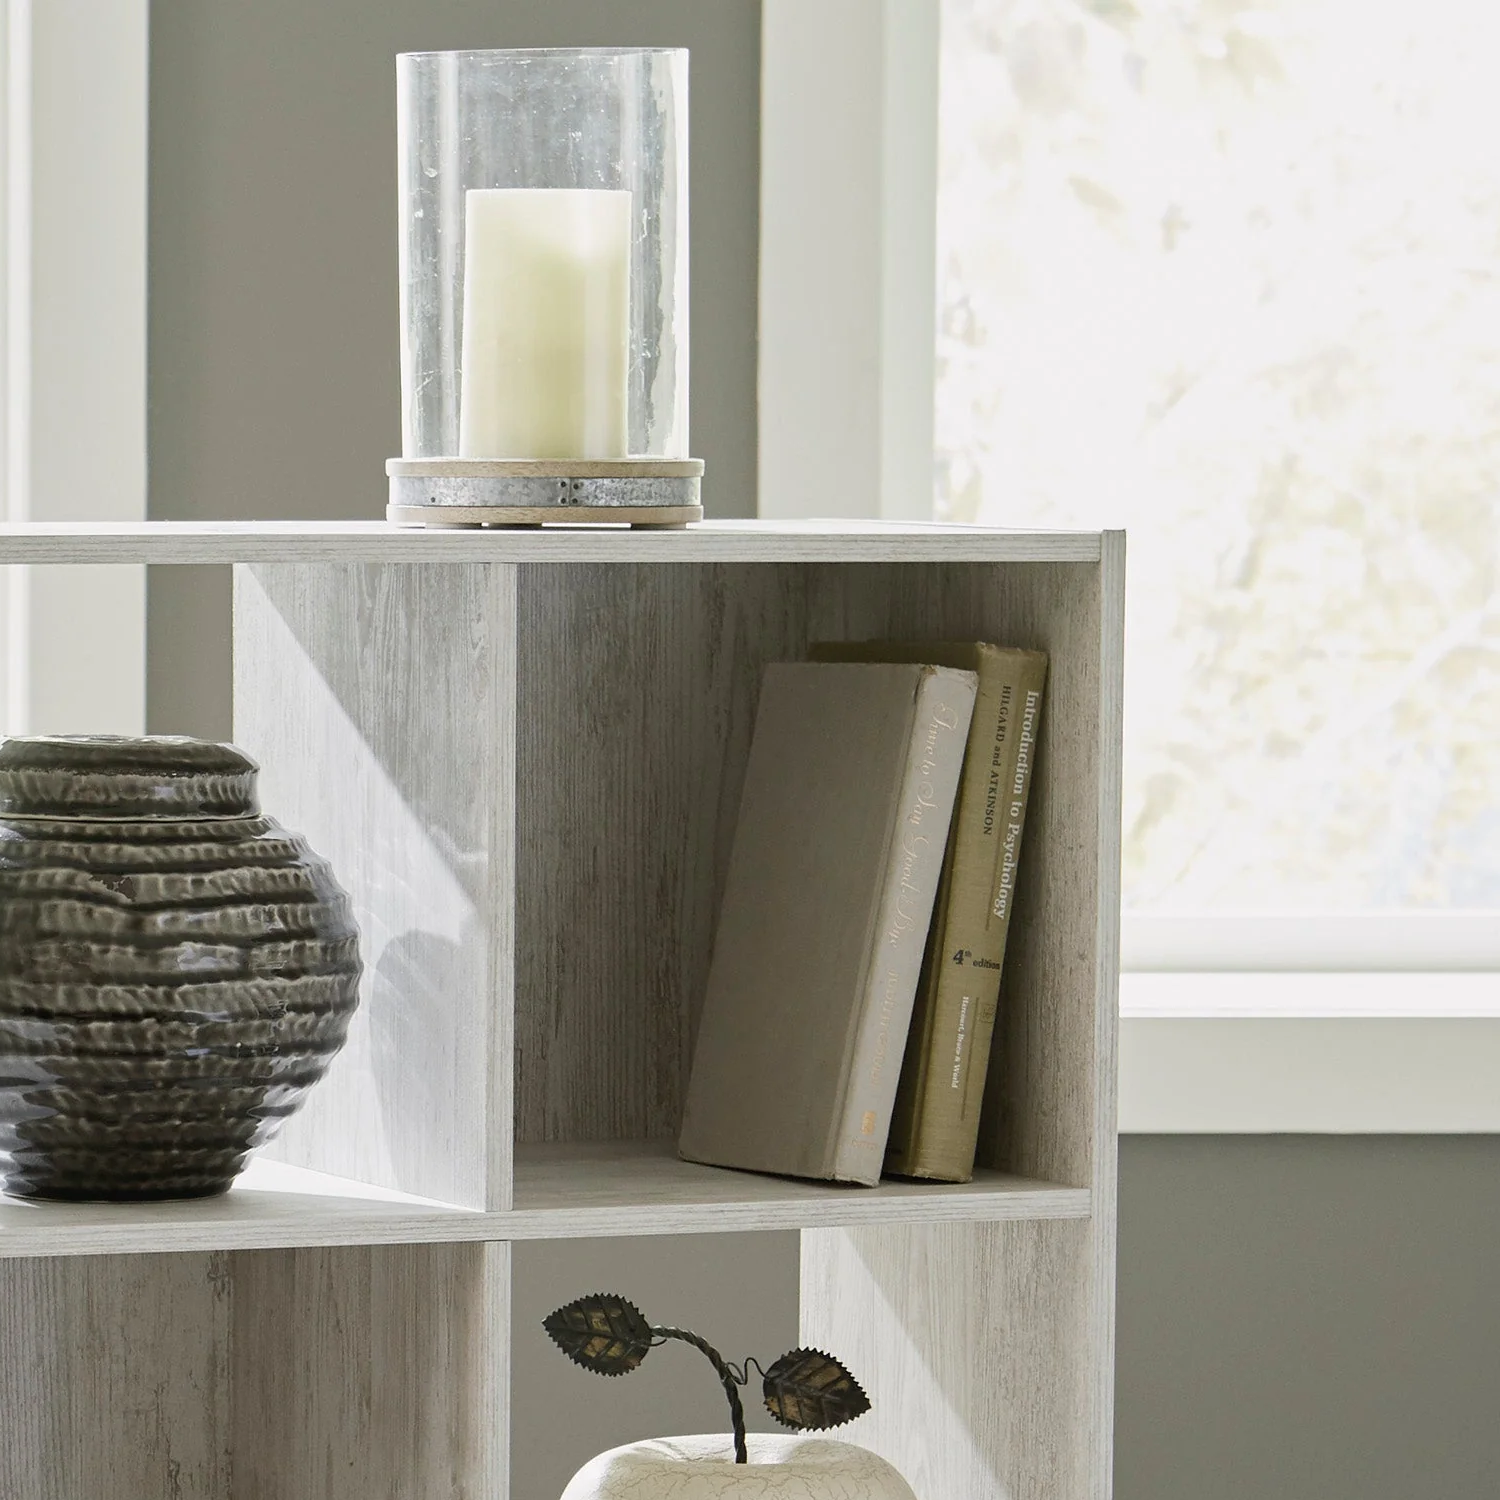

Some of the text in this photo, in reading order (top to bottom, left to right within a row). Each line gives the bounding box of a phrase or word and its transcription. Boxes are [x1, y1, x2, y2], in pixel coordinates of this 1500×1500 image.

[923, 701, 961, 758] Time
[919, 759, 936, 776] to
[981, 685, 1012, 835] HILGARD and ATKINSON
[990, 690, 1040, 919] Introduction to Psychology
[973, 957, 1000, 969] edition
